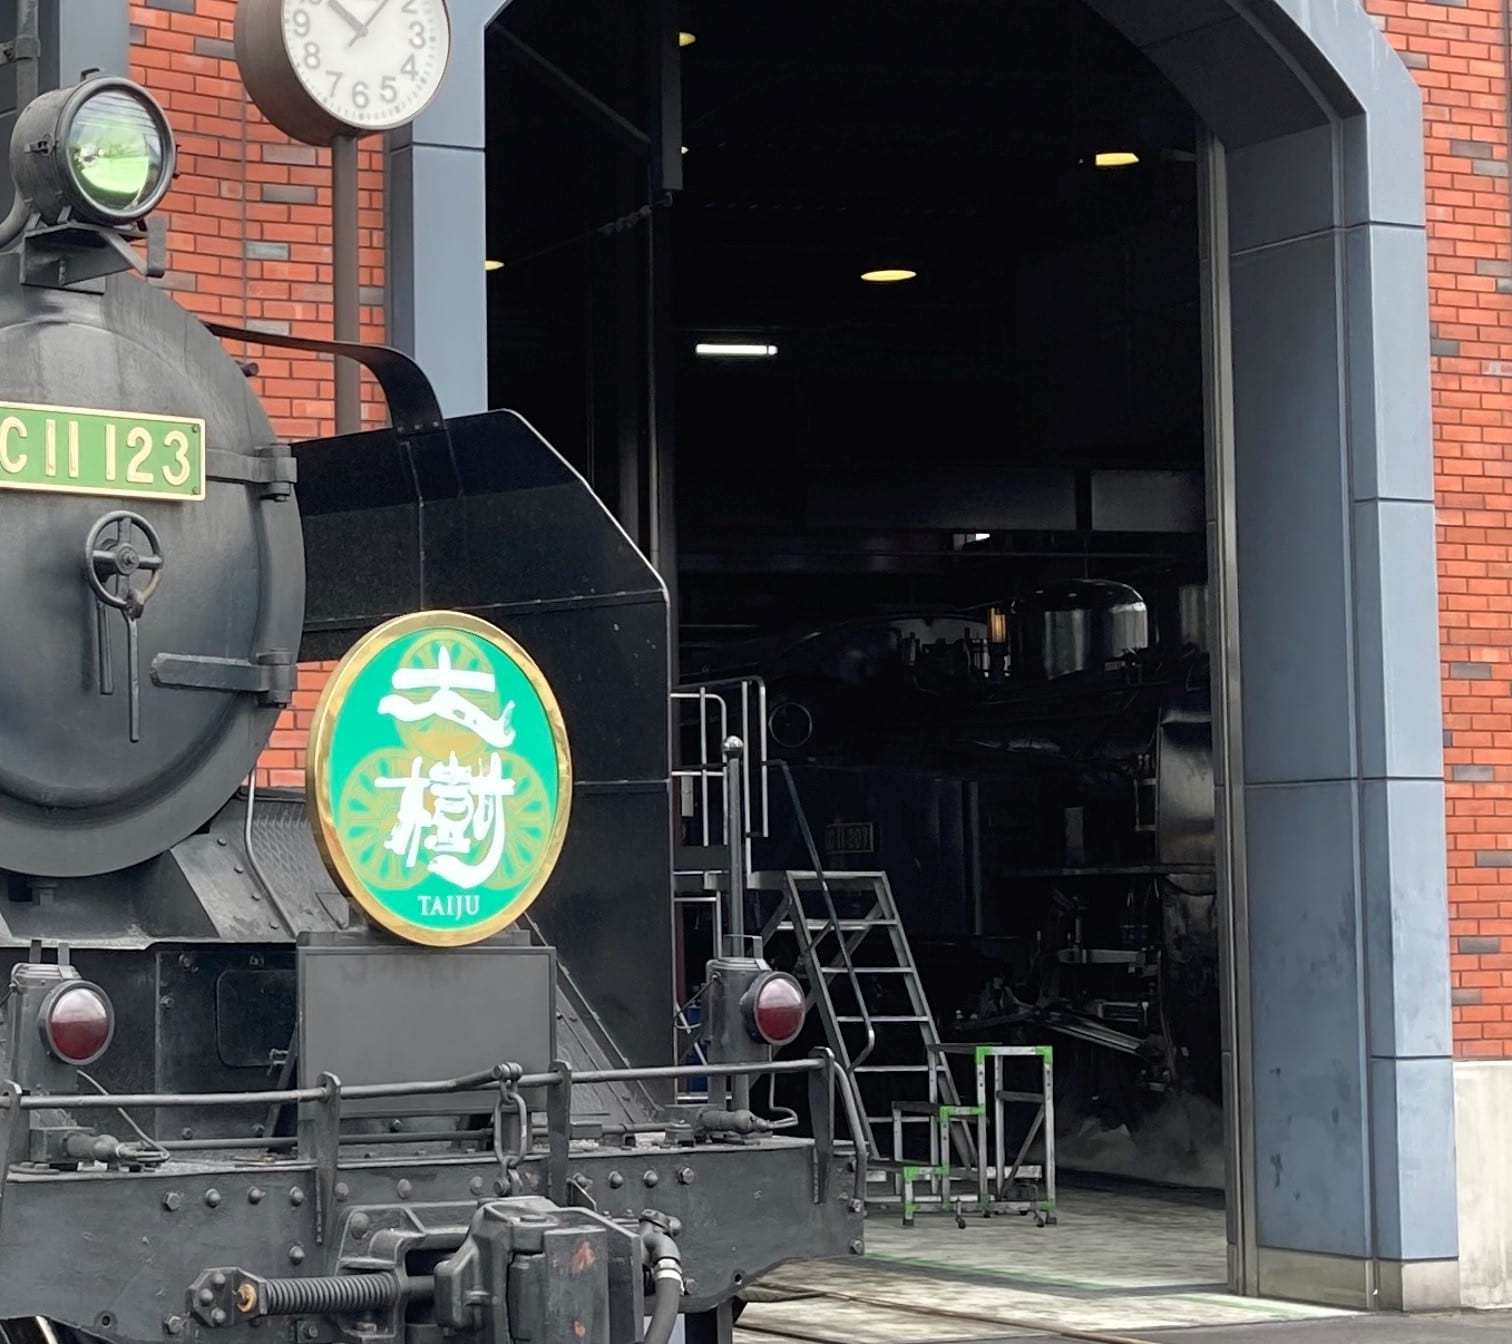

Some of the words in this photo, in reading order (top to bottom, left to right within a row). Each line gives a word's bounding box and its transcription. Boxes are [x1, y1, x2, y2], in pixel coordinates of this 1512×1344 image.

[292, 8, 311, 38] 9
[408, 21, 426, 50] 3
[303, 41, 321, 70] 8
[400, 53, 419, 81] 4
[326, 70, 343, 98] 7
[352, 80, 369, 109] 6
[379, 76, 398, 104] 5
[105, 423, 191, 486] 123
[417, 894, 481, 921] TAIJU
